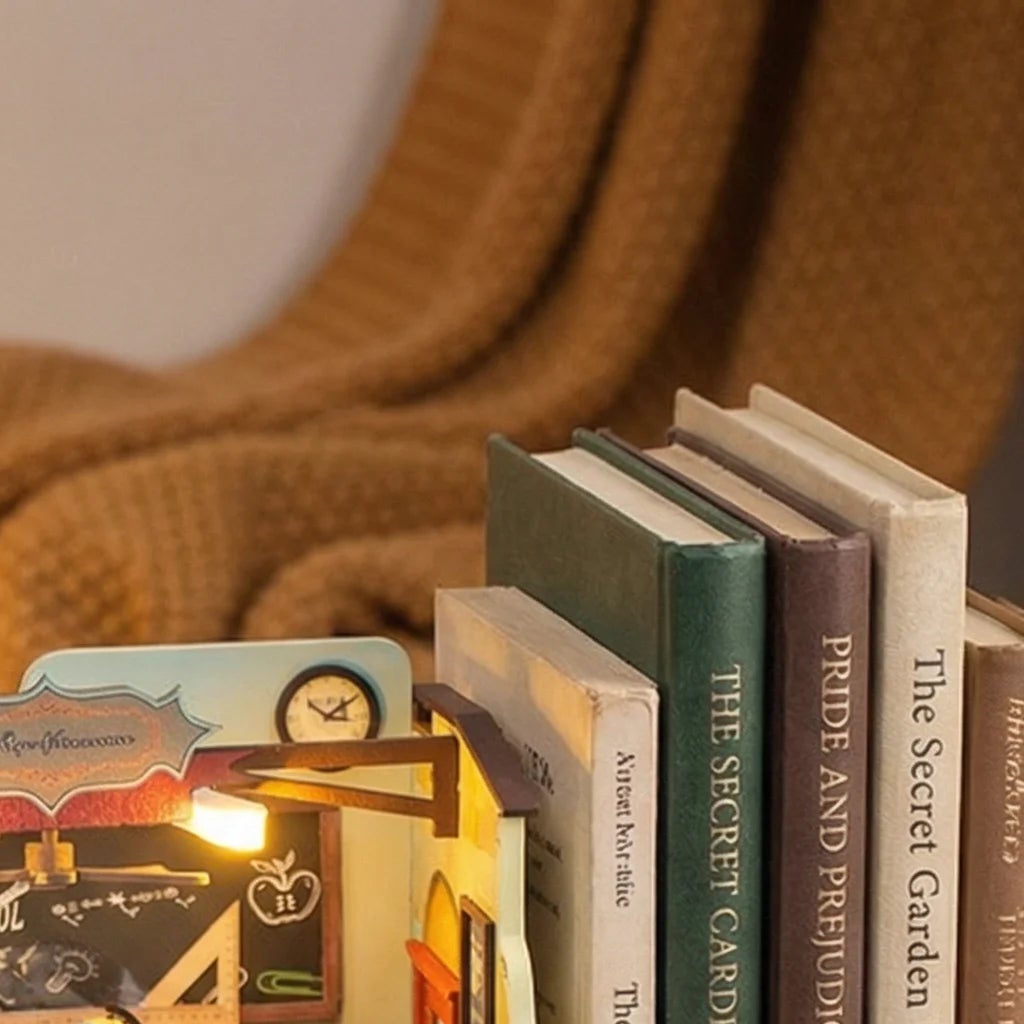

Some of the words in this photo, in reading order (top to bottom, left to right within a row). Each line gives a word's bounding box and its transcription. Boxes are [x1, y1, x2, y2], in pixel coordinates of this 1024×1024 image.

[710, 664, 741, 745] THE
[820, 634, 852, 753] PRIDE
[912, 648, 947, 723] The
[709, 756, 741, 896] SECRET
[819, 764, 848, 852] AND
[908, 738, 944, 854] Secret
[906, 869, 941, 1008] Garden
